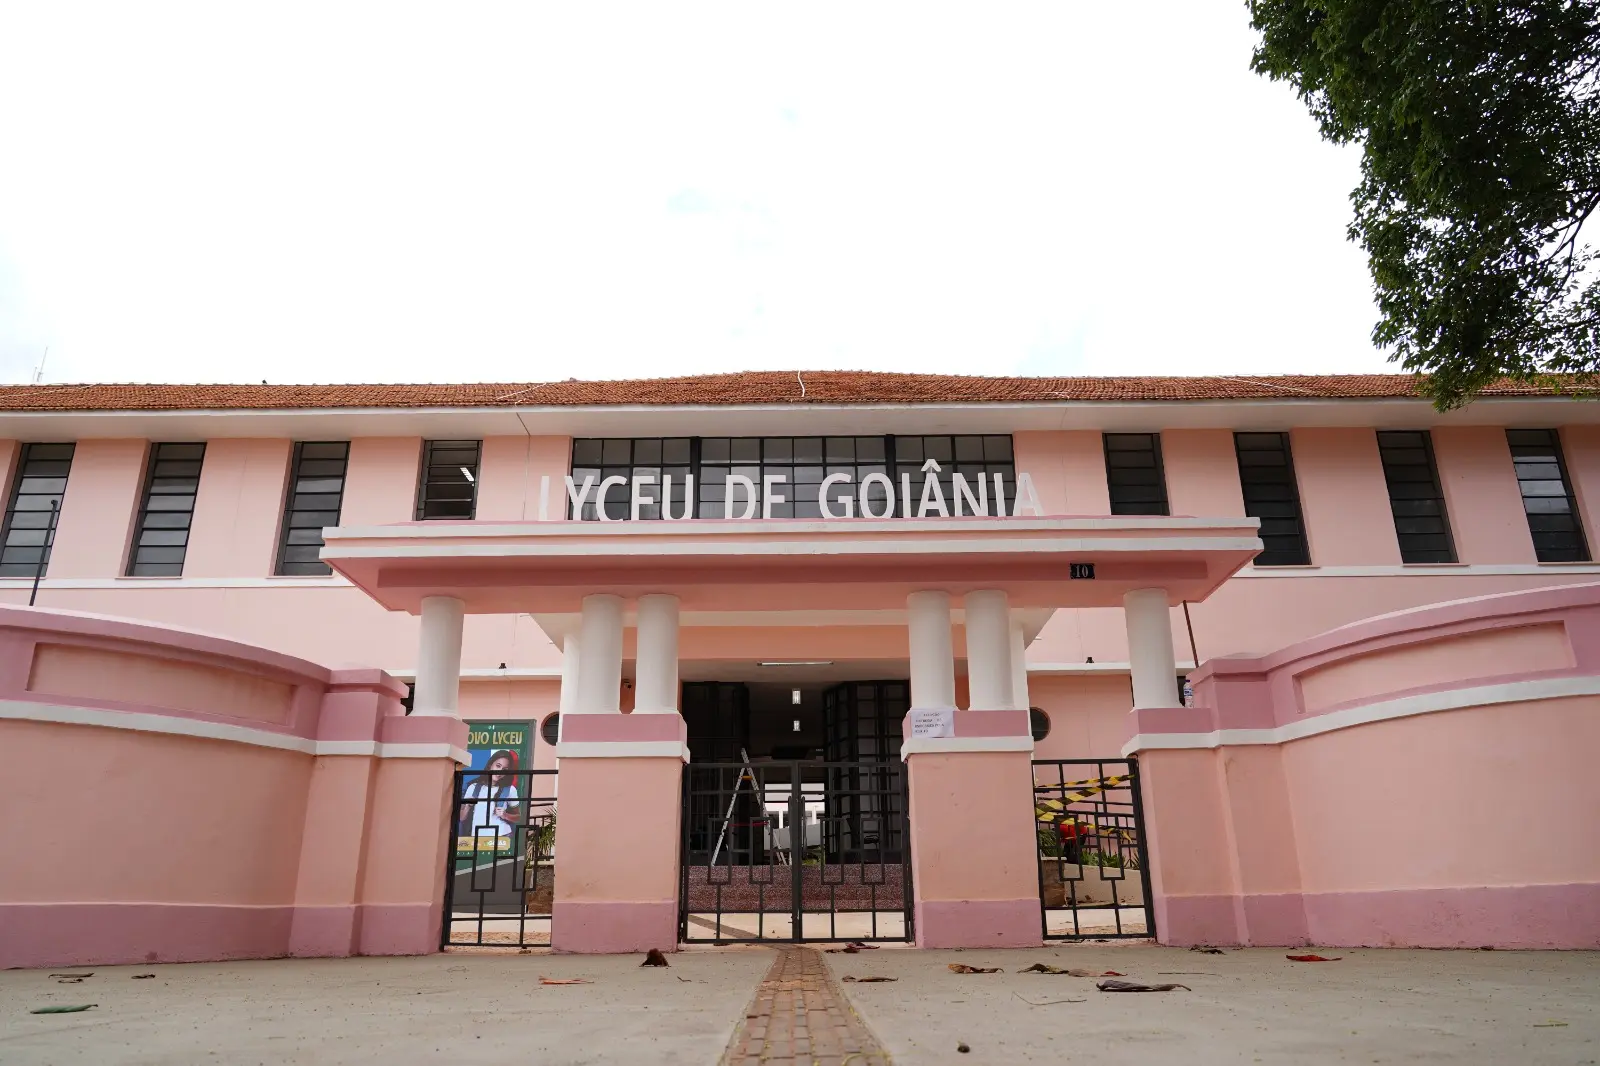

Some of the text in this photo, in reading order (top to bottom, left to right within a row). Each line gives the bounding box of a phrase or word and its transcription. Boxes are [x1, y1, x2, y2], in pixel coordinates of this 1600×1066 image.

[818, 458, 1045, 519] GOIÂNIA
[1075, 564, 1089, 578] 10
[468, 731, 523, 745] OVO LYCEU
